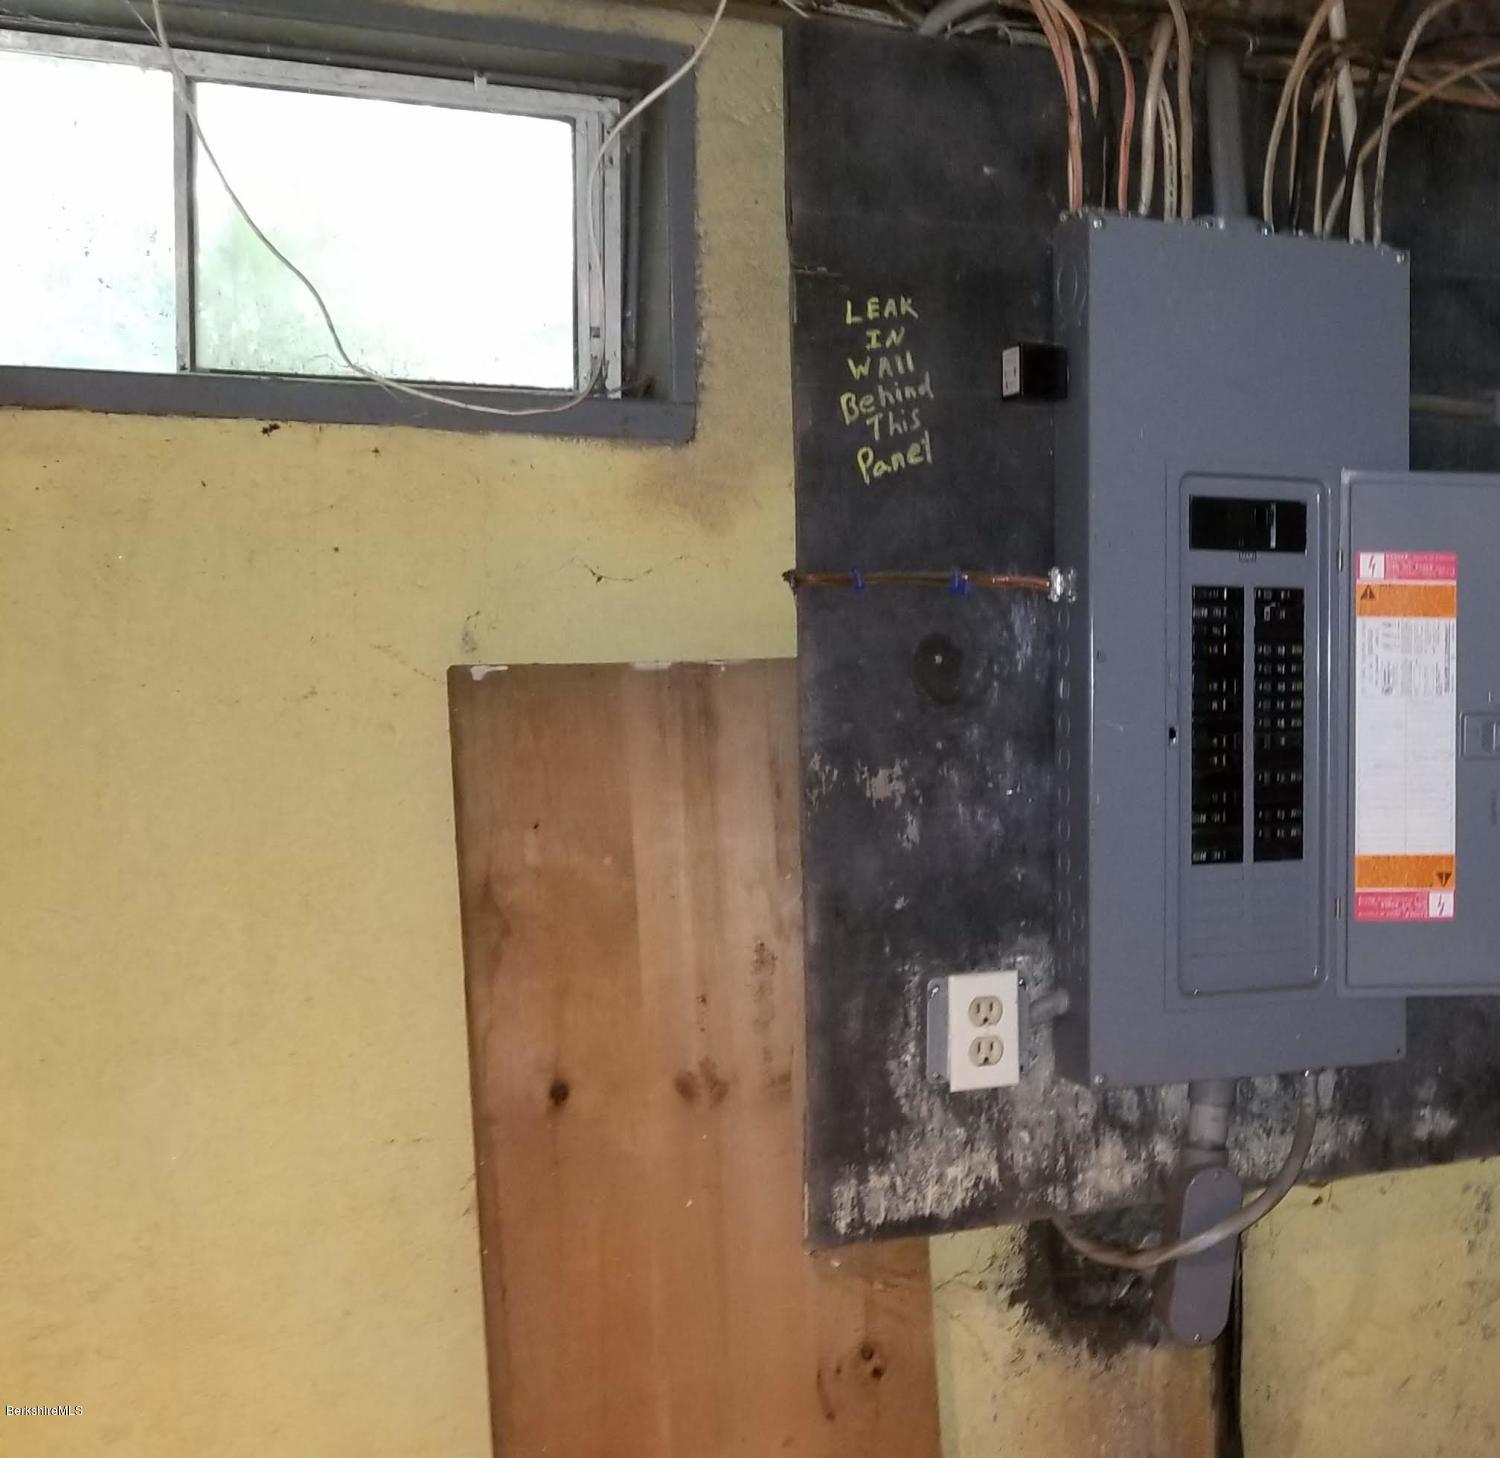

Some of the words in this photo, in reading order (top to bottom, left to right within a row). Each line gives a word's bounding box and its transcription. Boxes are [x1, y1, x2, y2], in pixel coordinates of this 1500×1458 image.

[846, 296, 919, 324] LEAK
[865, 326, 905, 350] IN
[840, 371, 934, 425] Behind
[866, 408, 921, 441] This
[857, 430, 933, 485] Panel
